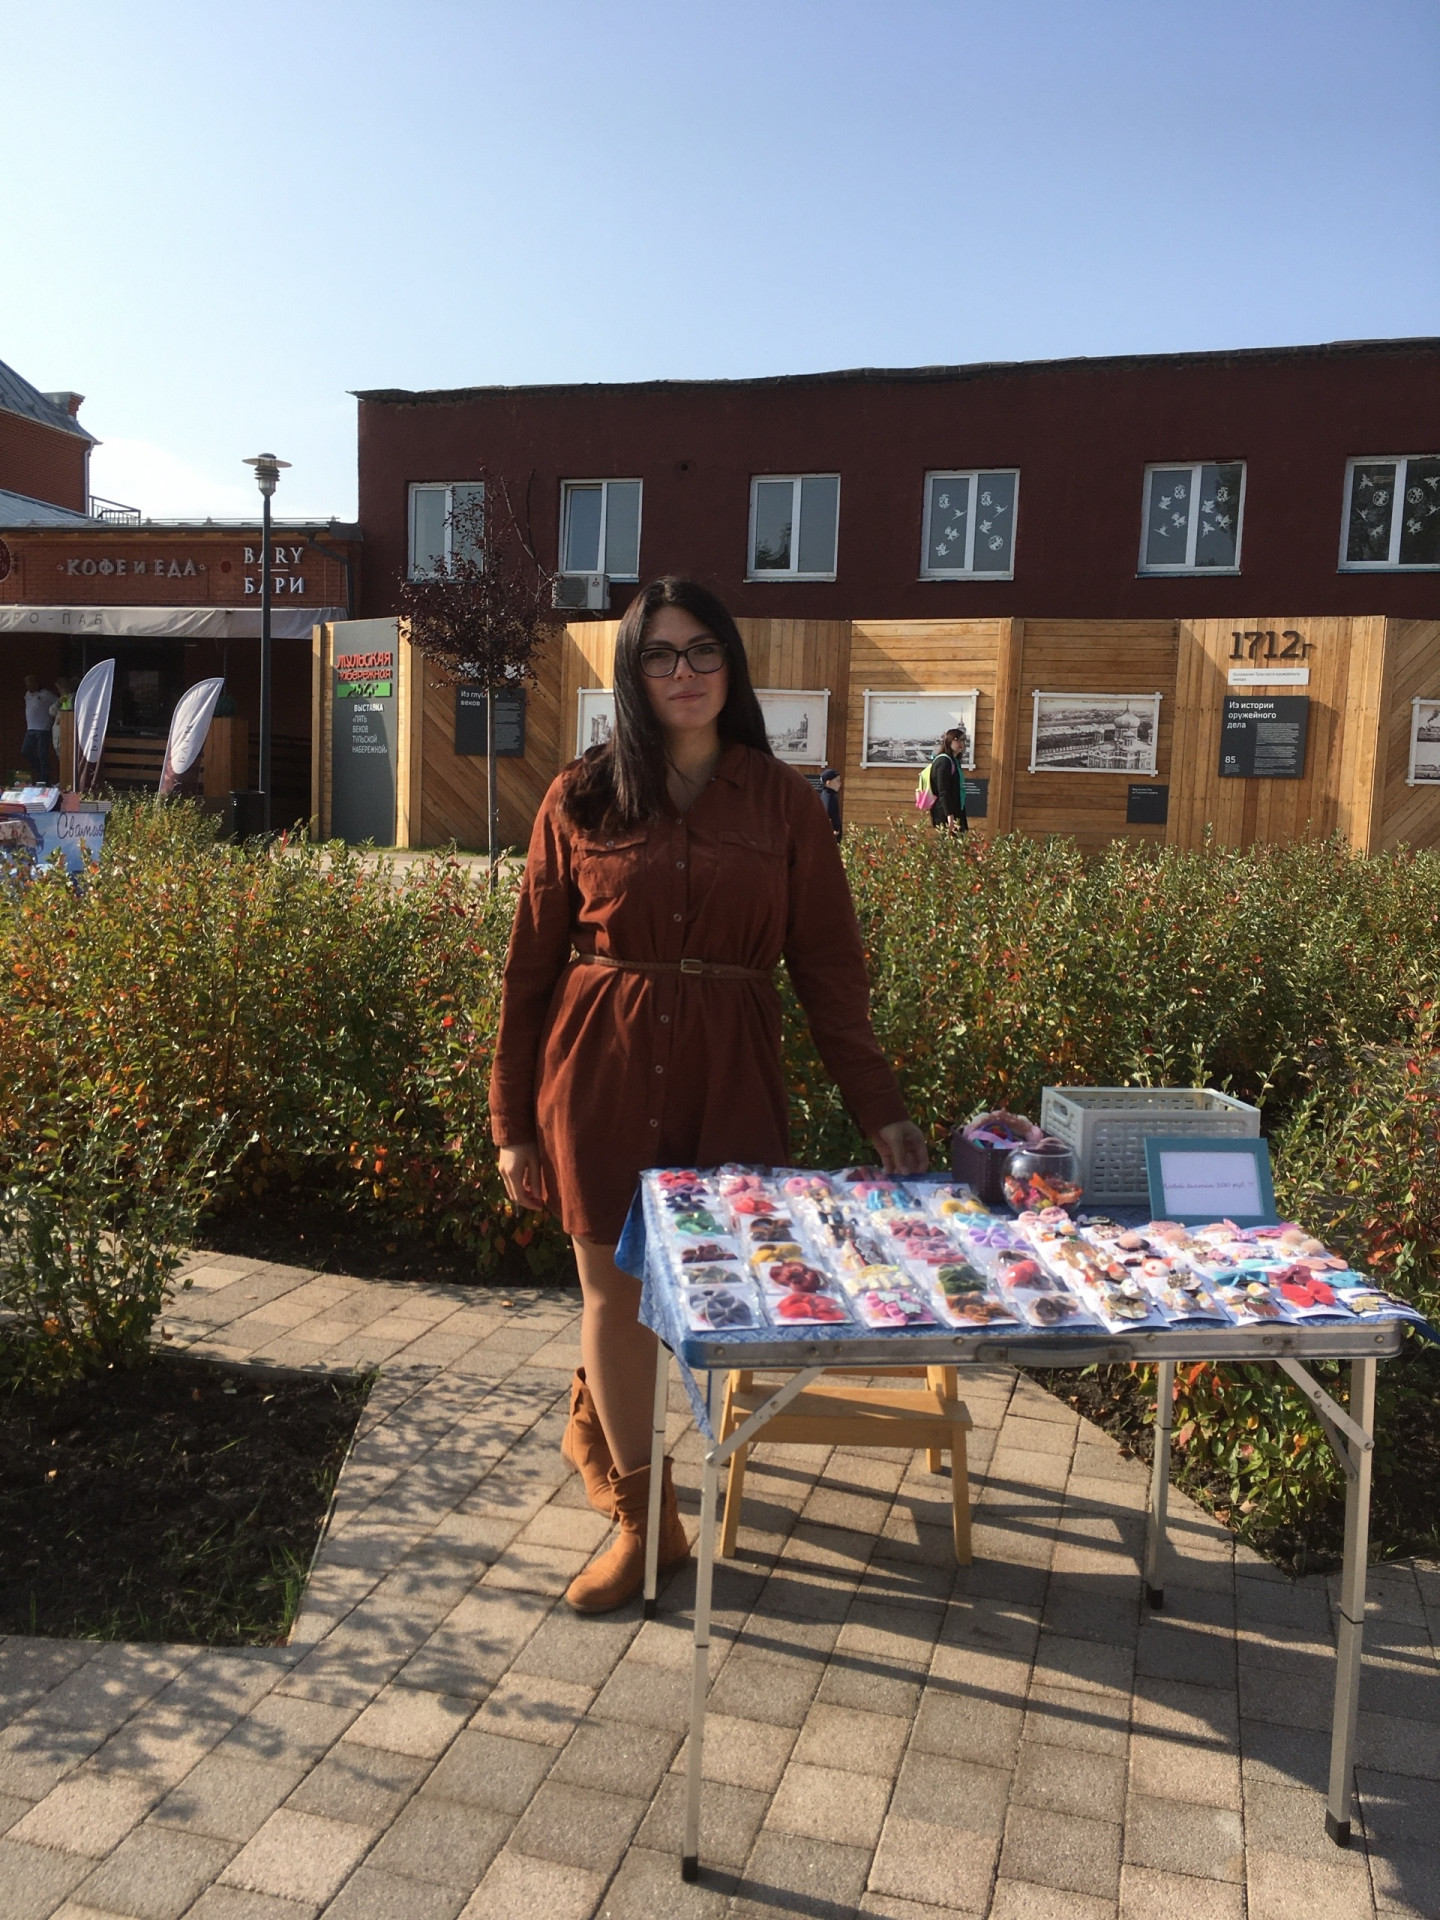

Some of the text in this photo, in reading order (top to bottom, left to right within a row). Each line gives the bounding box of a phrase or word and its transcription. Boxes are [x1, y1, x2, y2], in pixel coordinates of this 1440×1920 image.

[66, 558, 127, 577] КОФЕ
[154, 558, 198, 578] ЕДА
[353, 703, 384, 712] ВЫСТАВКА
[1229, 701, 1274, 711] Из истории
[1228, 711, 1277, 721] оружейного
[352, 725, 369, 734] ВЕКОВ
[351, 734, 378, 744] ТУЛЬСКОЙ
[1224, 755, 1237, 764] 85
